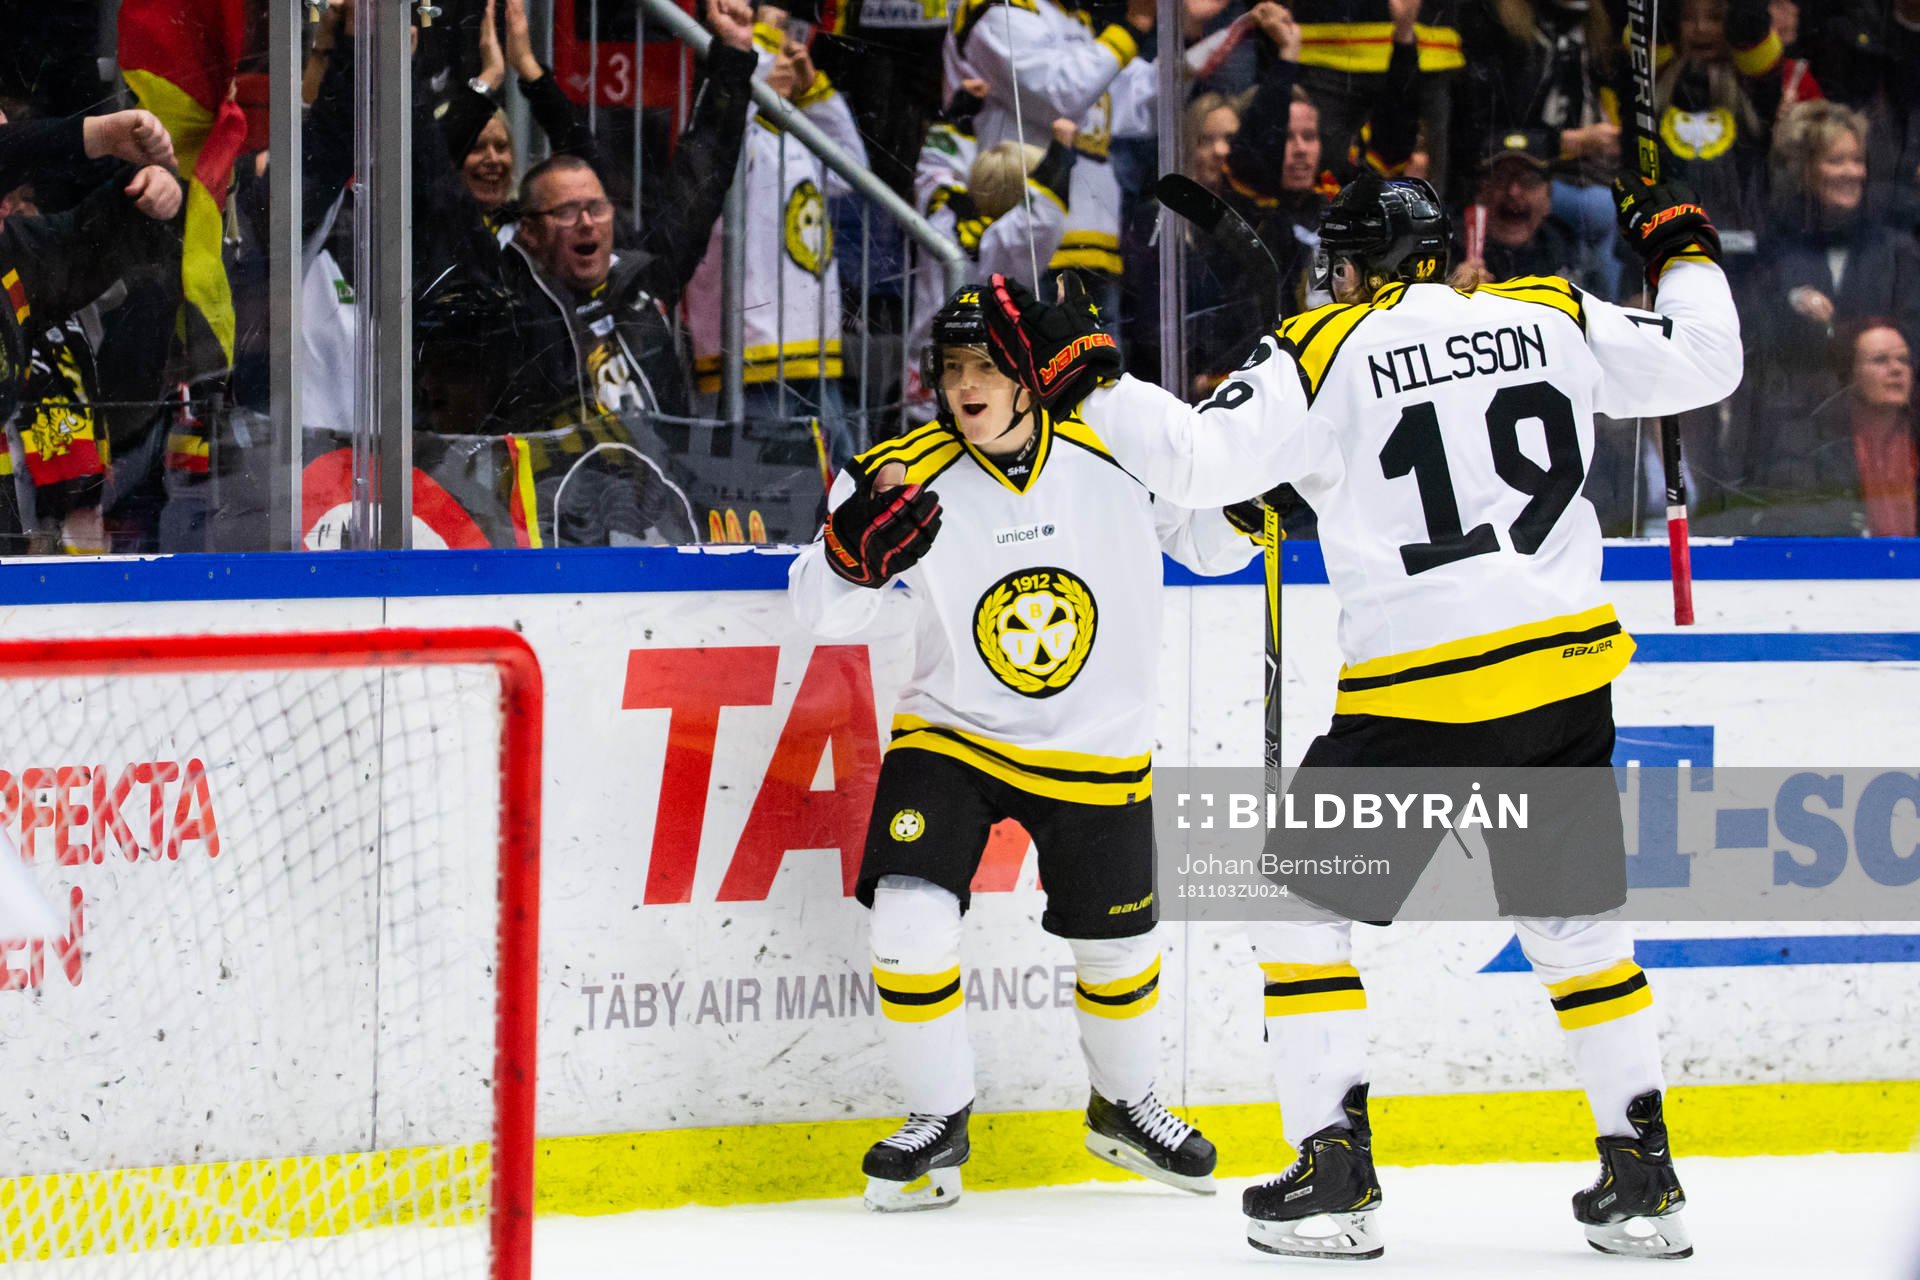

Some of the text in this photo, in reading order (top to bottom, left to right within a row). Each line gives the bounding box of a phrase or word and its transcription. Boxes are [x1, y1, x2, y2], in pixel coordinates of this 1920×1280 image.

[603, 53, 630, 101] 3
[1415, 257, 1437, 280] 19
[1367, 324, 1547, 399] NILSSON
[1378, 380, 1585, 576] 19
[996, 526, 1039, 544] unicef
[1012, 573, 1050, 594] 1912
[621, 644, 1046, 906] TA
[580, 964, 1077, 1031] TÄBY AIR MAINANCE
